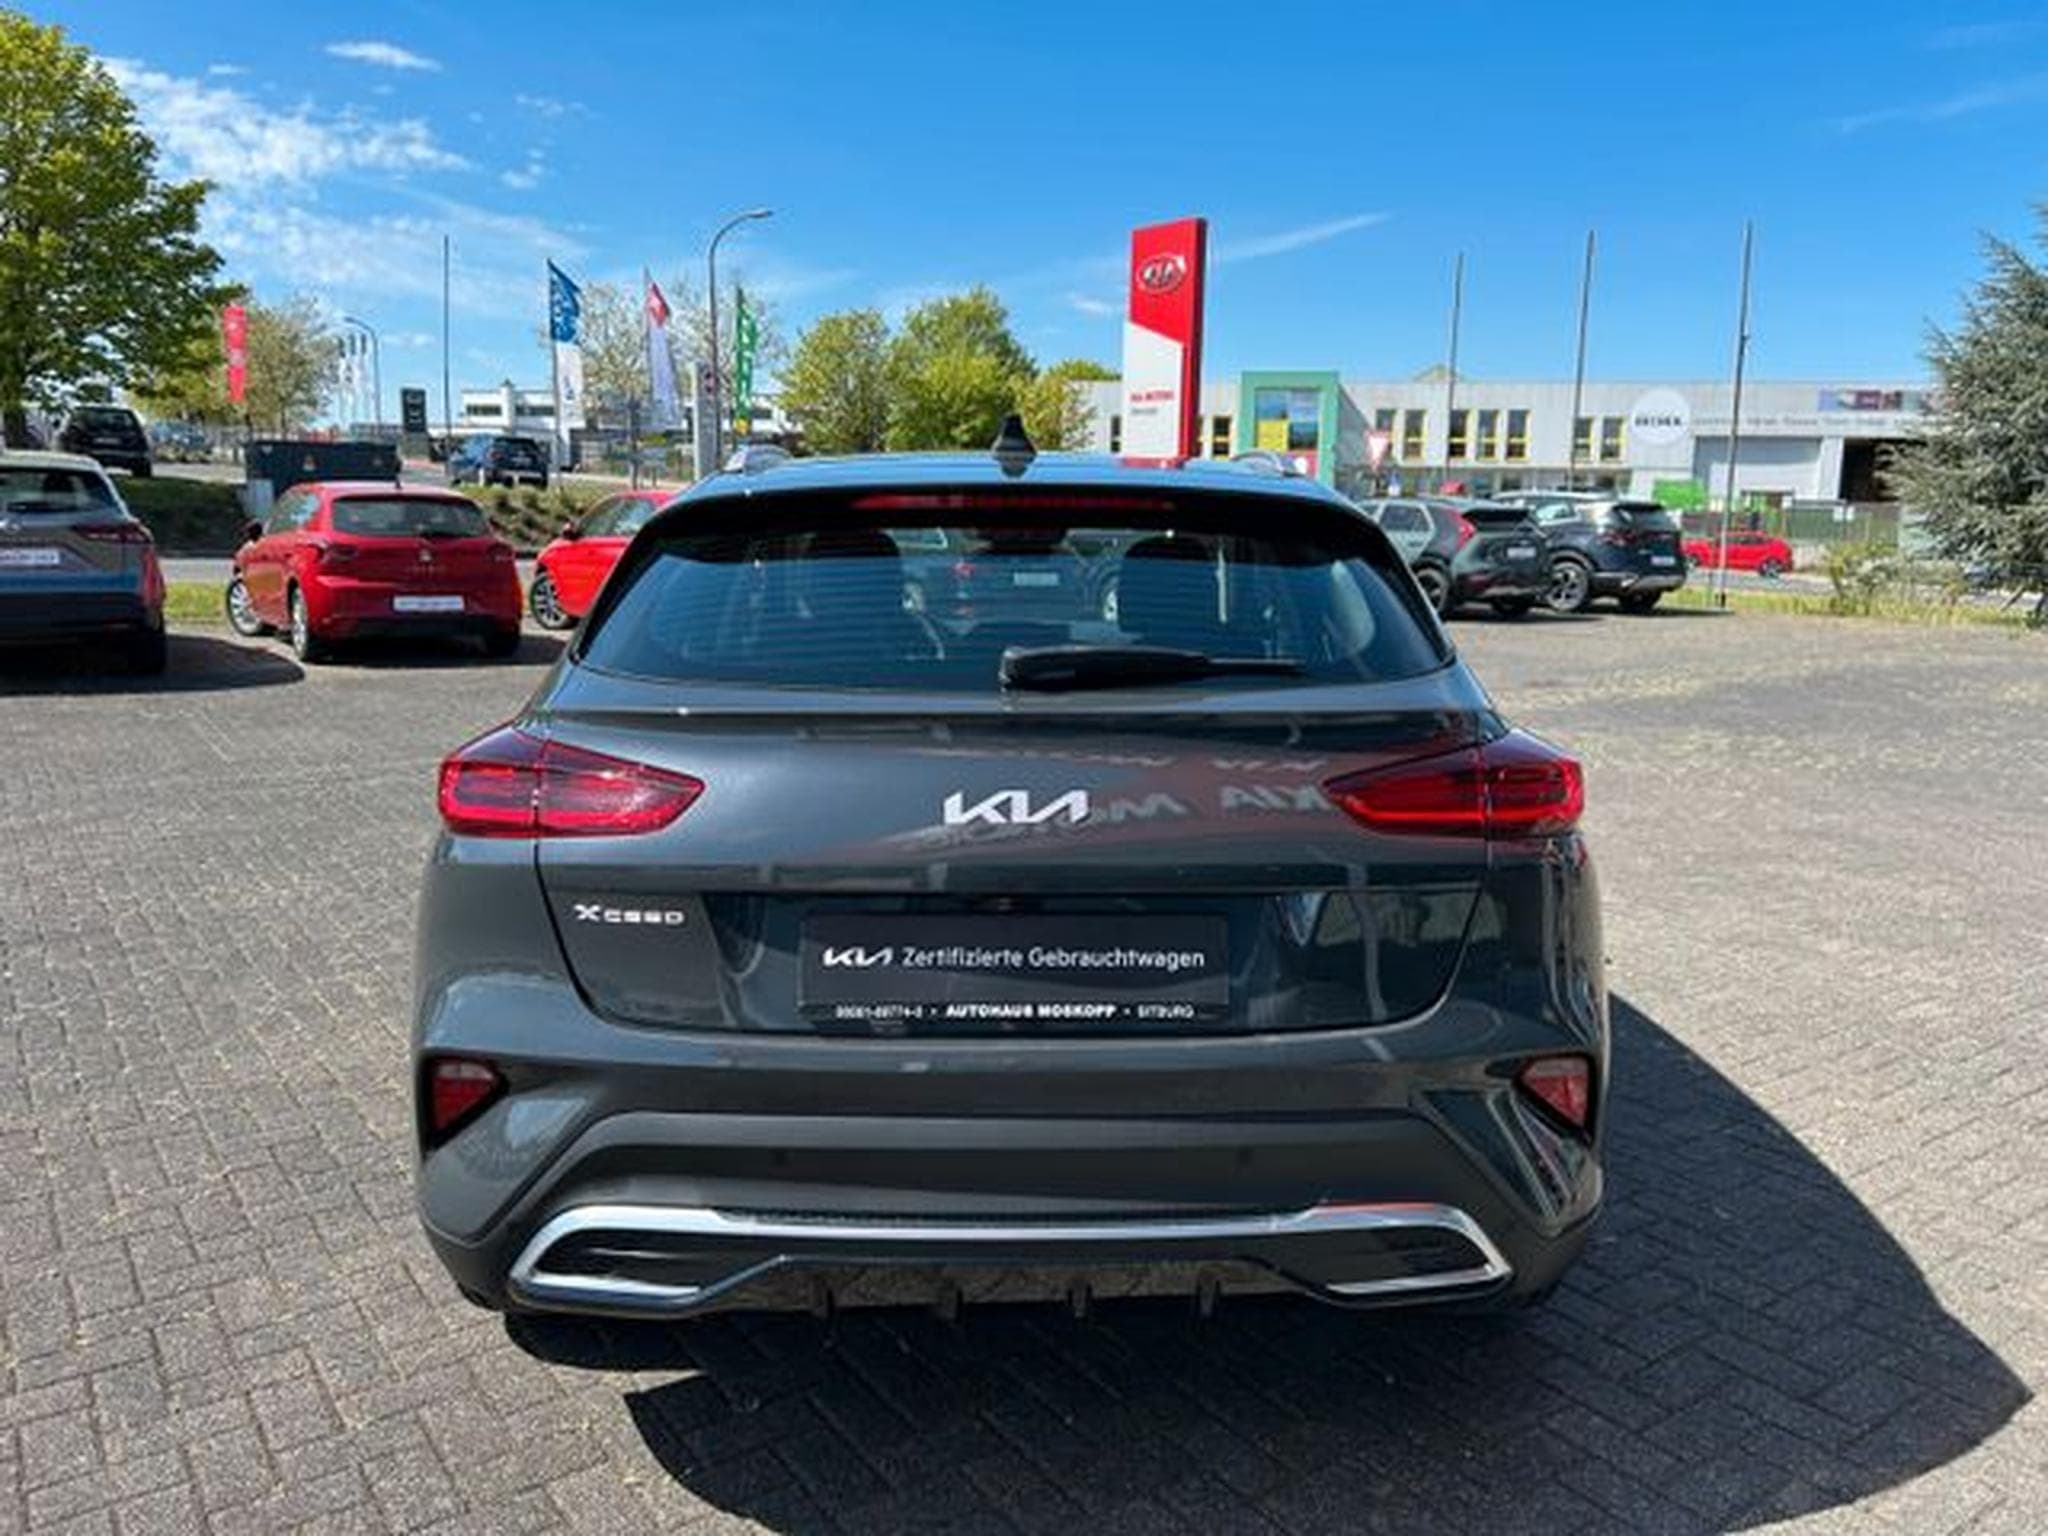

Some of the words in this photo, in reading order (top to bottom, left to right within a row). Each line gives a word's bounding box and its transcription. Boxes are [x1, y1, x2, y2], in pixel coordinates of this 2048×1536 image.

[943, 788, 1089, 825] KIA
[822, 947, 894, 967] KIA
[901, 947, 1023, 968] Zertifizierte
[1028, 947, 1205, 973] Gebrauchtwagen
[946, 1003, 1034, 1019] AUTOHAUS
[1037, 1003, 1117, 1019] MOSKOPP
